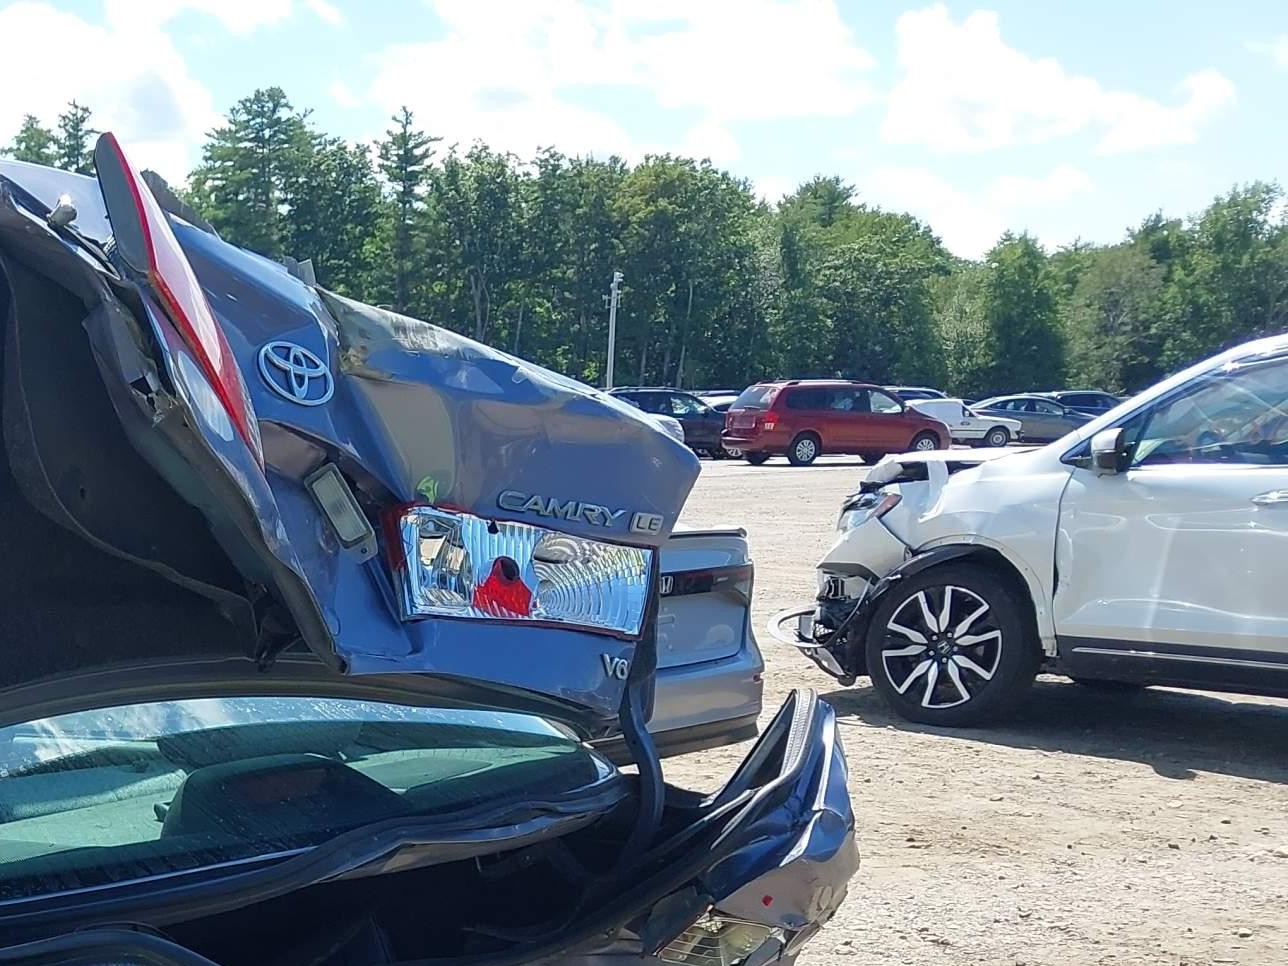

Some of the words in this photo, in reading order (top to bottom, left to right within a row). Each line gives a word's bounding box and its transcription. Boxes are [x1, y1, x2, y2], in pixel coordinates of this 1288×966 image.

[497, 490, 627, 527] CAMRY
[634, 513, 662, 533] LE
[601, 653, 628, 680] V6
